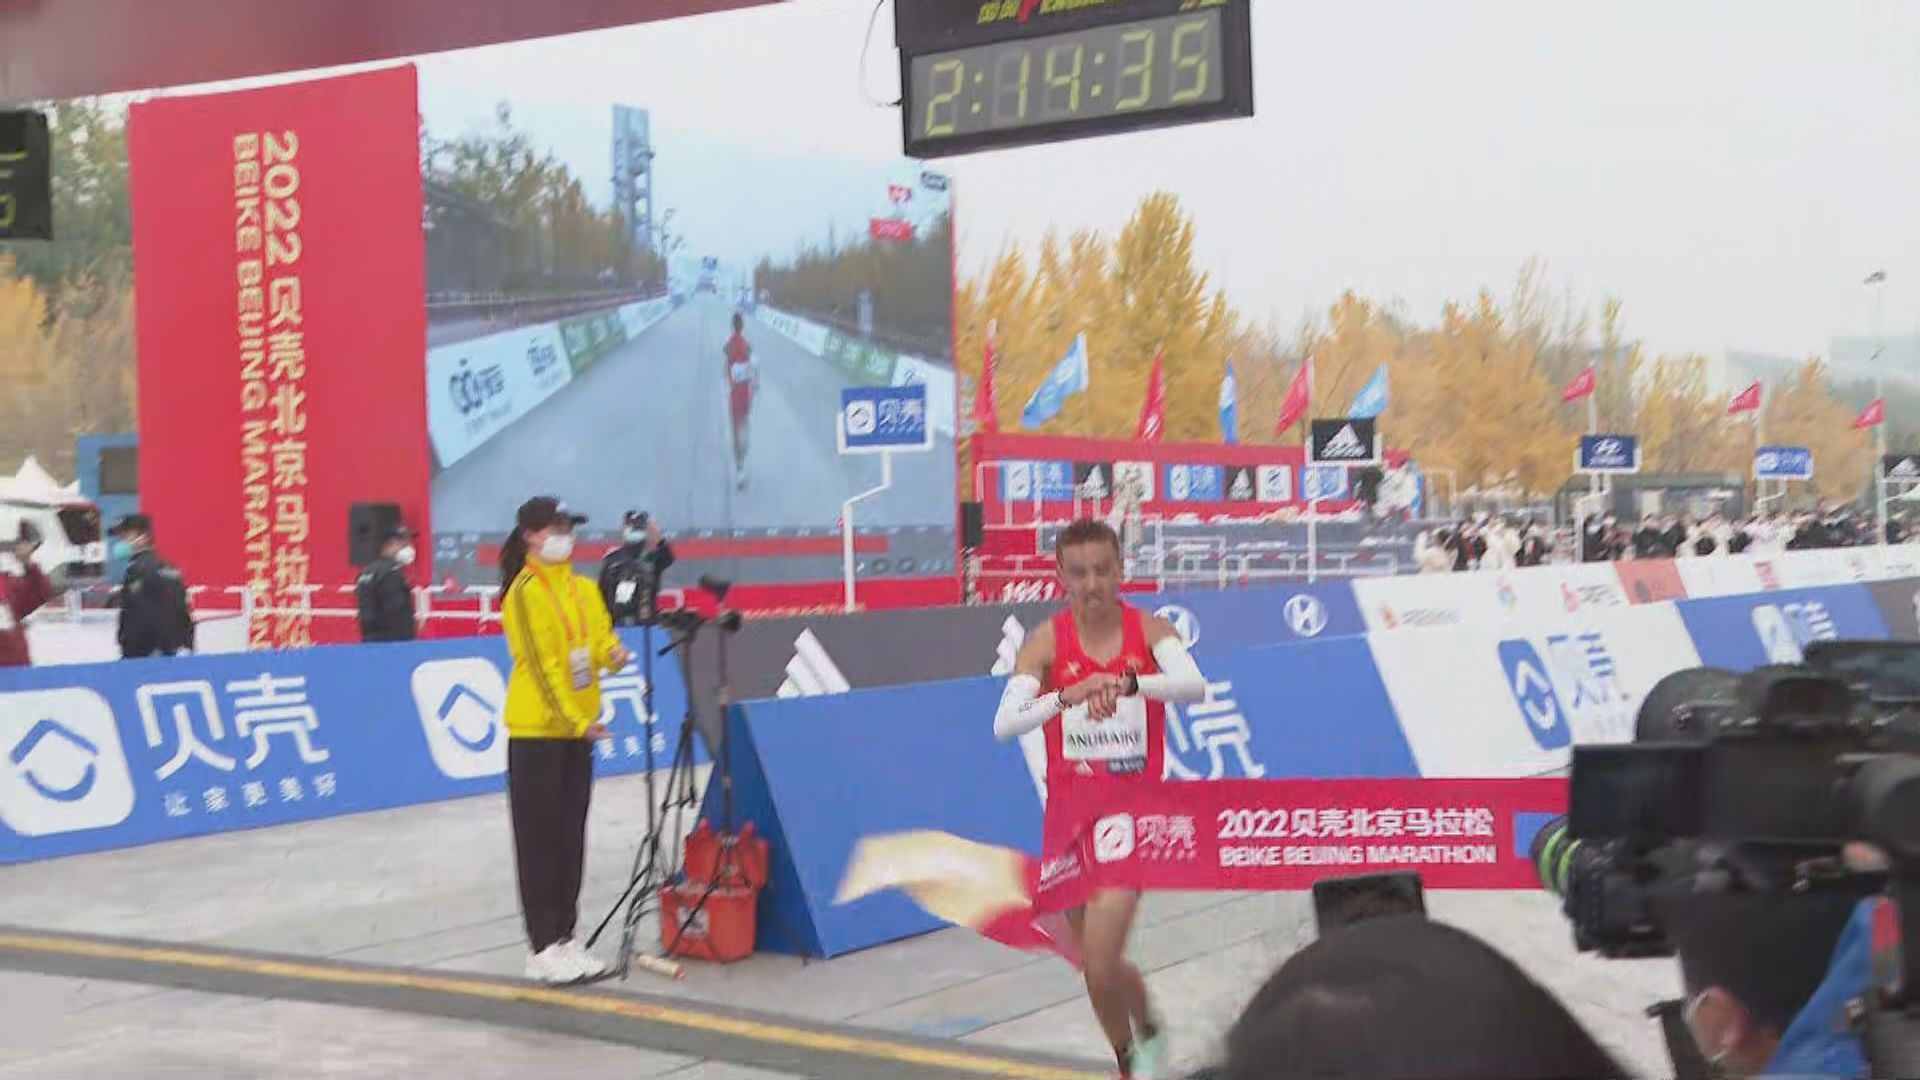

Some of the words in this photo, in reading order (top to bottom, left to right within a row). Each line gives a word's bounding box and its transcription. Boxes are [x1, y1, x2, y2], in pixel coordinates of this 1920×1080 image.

[926, 19, 1209, 137] 2:14:35
[233, 133, 262, 252] BEIKE
[263, 130, 302, 266] 2022
[237, 259, 267, 411] BEIJING
[136, 672, 331, 781] 贝壳
[1219, 846, 1282, 866] BEIKE
[1366, 844, 1496, 863] MARATHON
